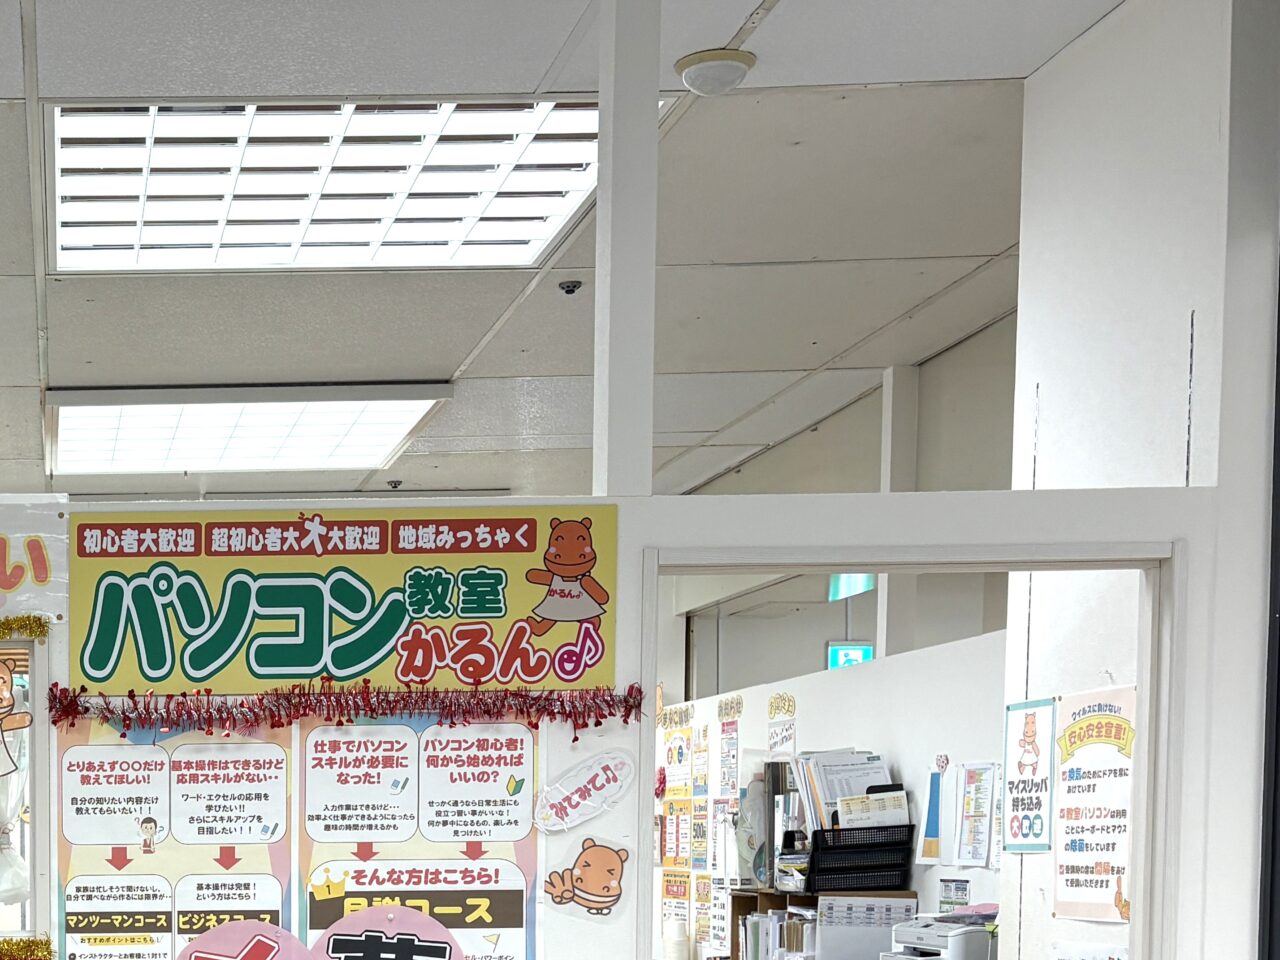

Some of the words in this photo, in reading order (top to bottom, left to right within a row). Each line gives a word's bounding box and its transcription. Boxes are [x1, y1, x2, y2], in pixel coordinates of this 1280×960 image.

[83, 528, 195, 553] 初心者大歓迎
[398, 523, 529, 549] 地域みっちゃく
[405, 566, 506, 620] 教室
[80, 561, 413, 683] パソコン
[314, 740, 408, 753] 仕事でパソコン
[171, 759, 284, 771] 基本操作はできるけど
[312, 756, 408, 768] スキルが必要に
[426, 754, 523, 767] 何から始めれば
[1008, 777, 1048, 794] マイスリッパ
[1067, 784, 1096, 793] あけています
[71, 797, 159, 805] 自分の知りたい内容だけ
[182, 793, 269, 801] ワード・エクセルの応用を
[1012, 797, 1042, 812] 持ち込み
[308, 813, 415, 821] 効率よく仕事ができるようになったら
[1066, 808, 1127, 820] 教室パソコンは利用
[1065, 825, 1127, 835] ごとにキーボードとマウス
[1065, 839, 1116, 852] の除菌をしています
[67, 914, 167, 927] マンツーマンコース
